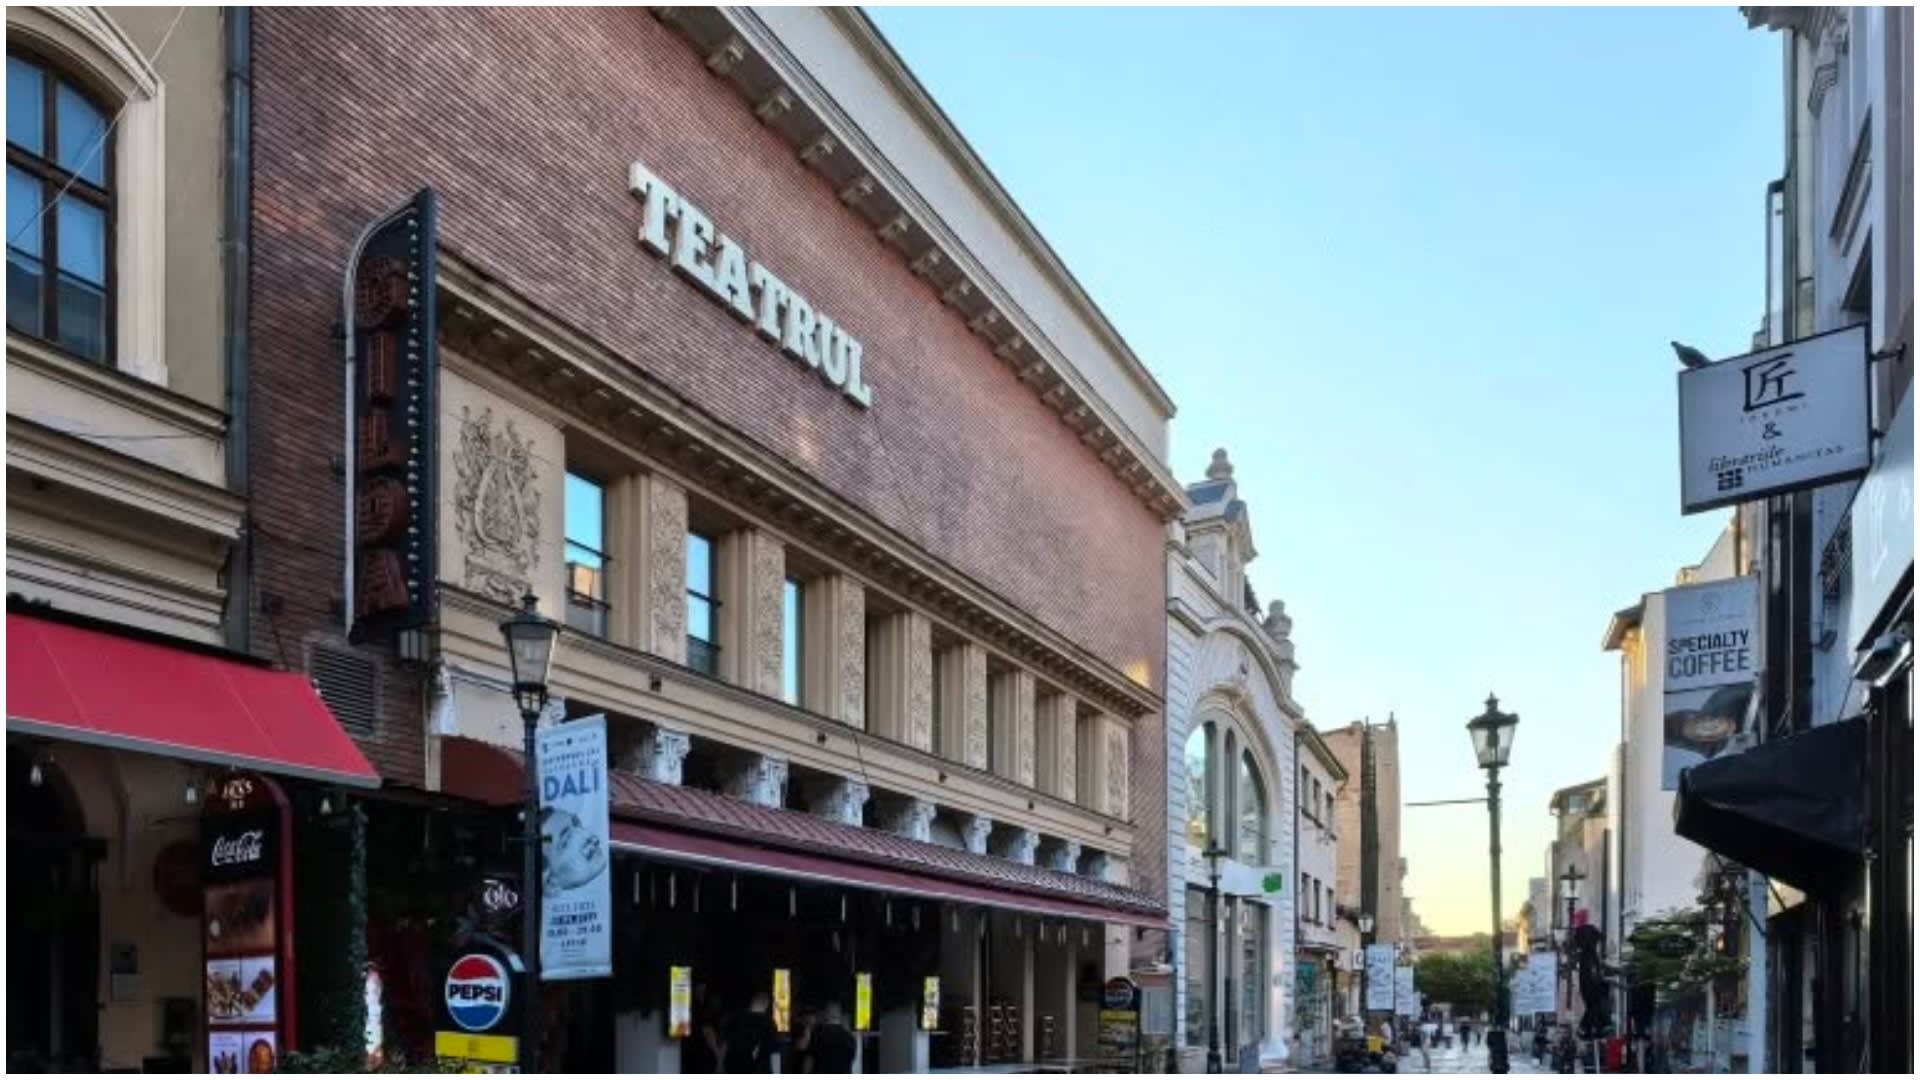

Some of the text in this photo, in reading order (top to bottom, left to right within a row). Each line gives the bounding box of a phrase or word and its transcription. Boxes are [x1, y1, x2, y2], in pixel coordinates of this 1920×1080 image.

[629, 160, 872, 408] TEATRUL
[1742, 352, 1806, 413] 匠
[1762, 421, 1783, 440] &
[1668, 629, 1750, 655] SPECIALTY
[1669, 649, 1751, 678] COFFEE
[449, 984, 504, 1003] PEPSI
